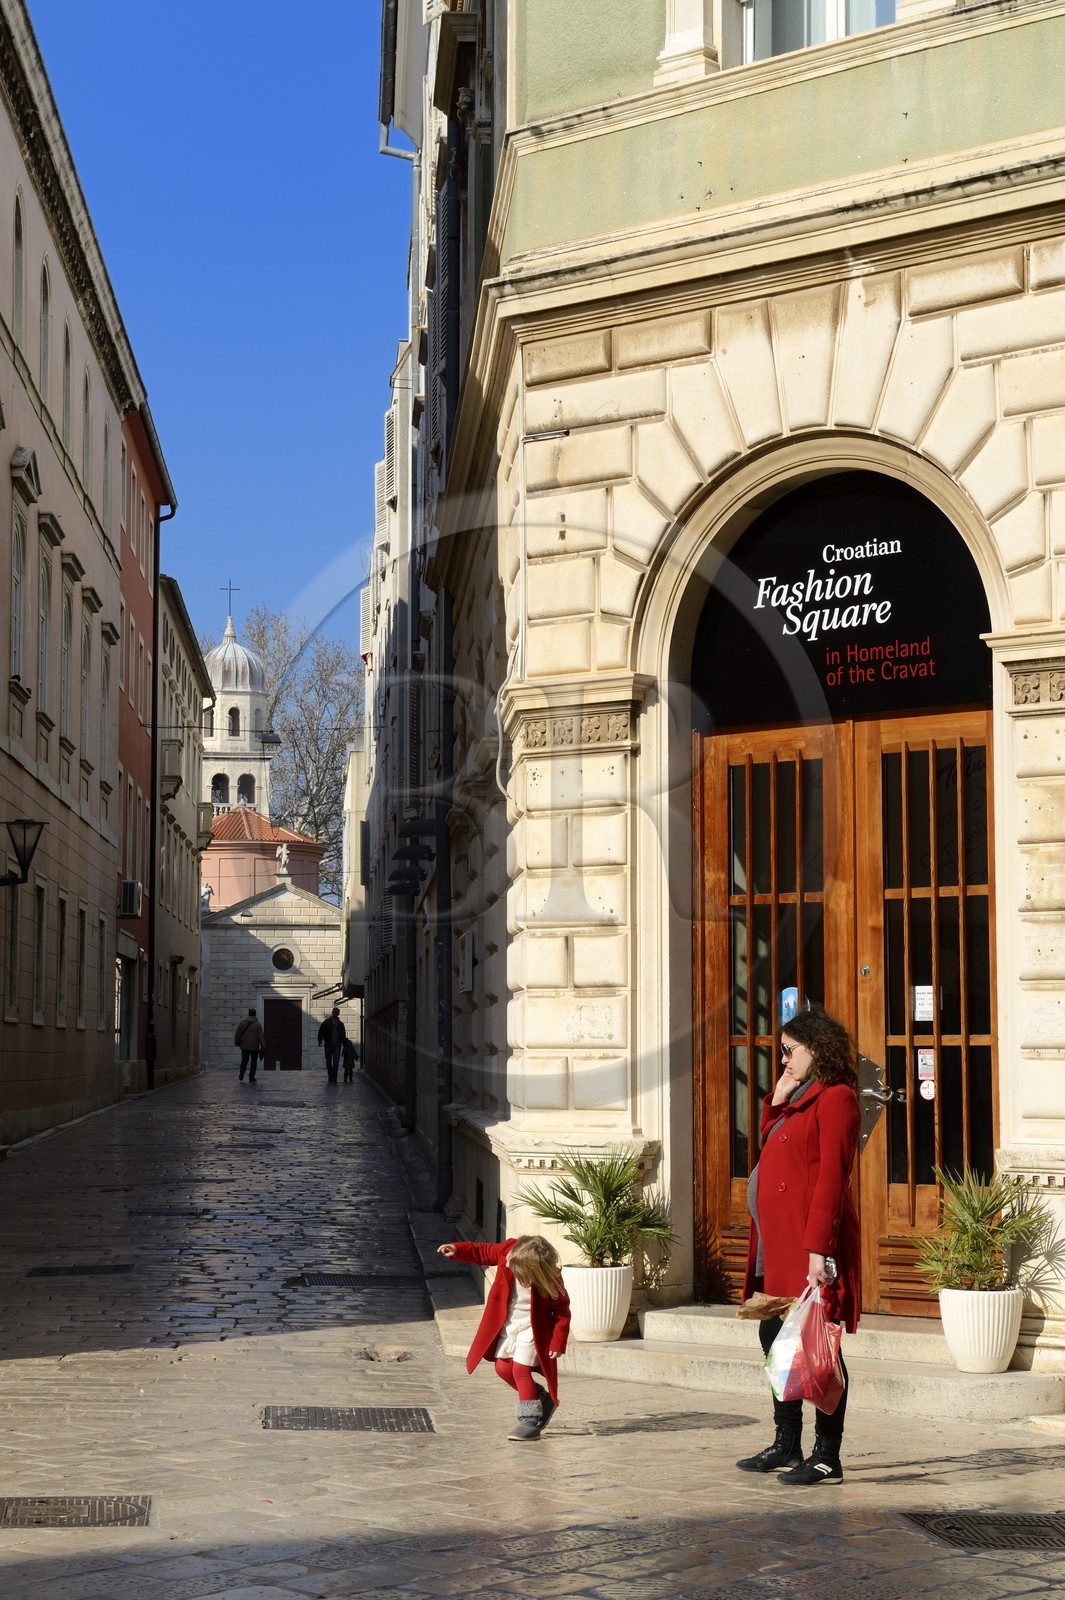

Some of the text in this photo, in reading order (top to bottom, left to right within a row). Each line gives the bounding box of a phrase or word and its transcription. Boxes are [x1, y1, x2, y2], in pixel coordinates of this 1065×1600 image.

[822, 538, 902, 563] Croatian
[753, 568, 873, 609] Fashion
[782, 600, 892, 641] Square
[825, 636, 931, 665] in Homeland
[826, 659, 936, 686] of the Cravat
